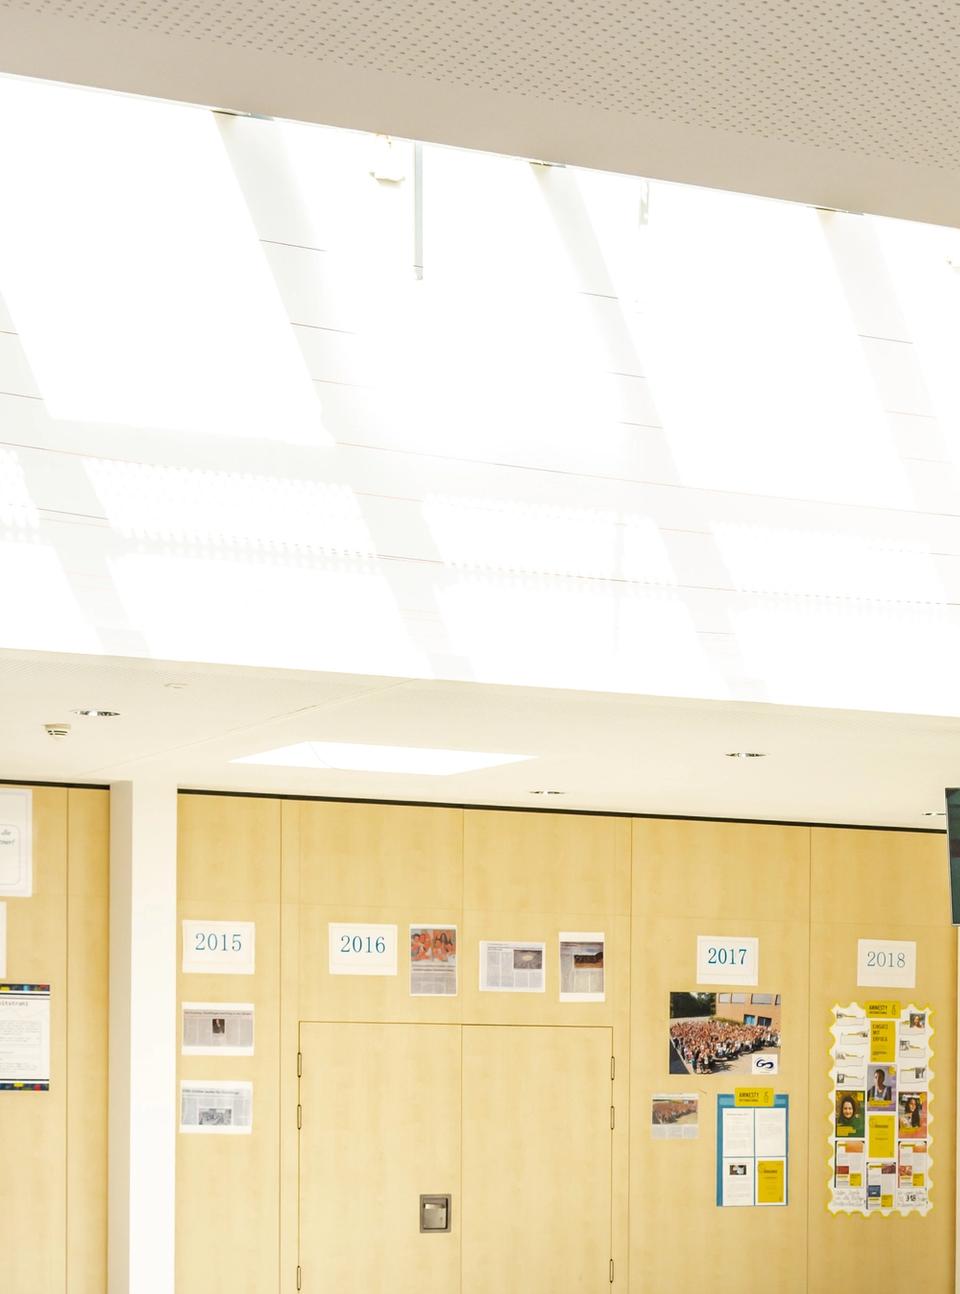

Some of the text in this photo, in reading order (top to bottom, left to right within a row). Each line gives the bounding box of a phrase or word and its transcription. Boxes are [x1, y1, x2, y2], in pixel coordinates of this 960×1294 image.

[195, 933, 242, 952] 2015
[340, 935, 386, 954] 2016
[708, 947, 747, 965] 2017
[867, 951, 906, 969] 2018
